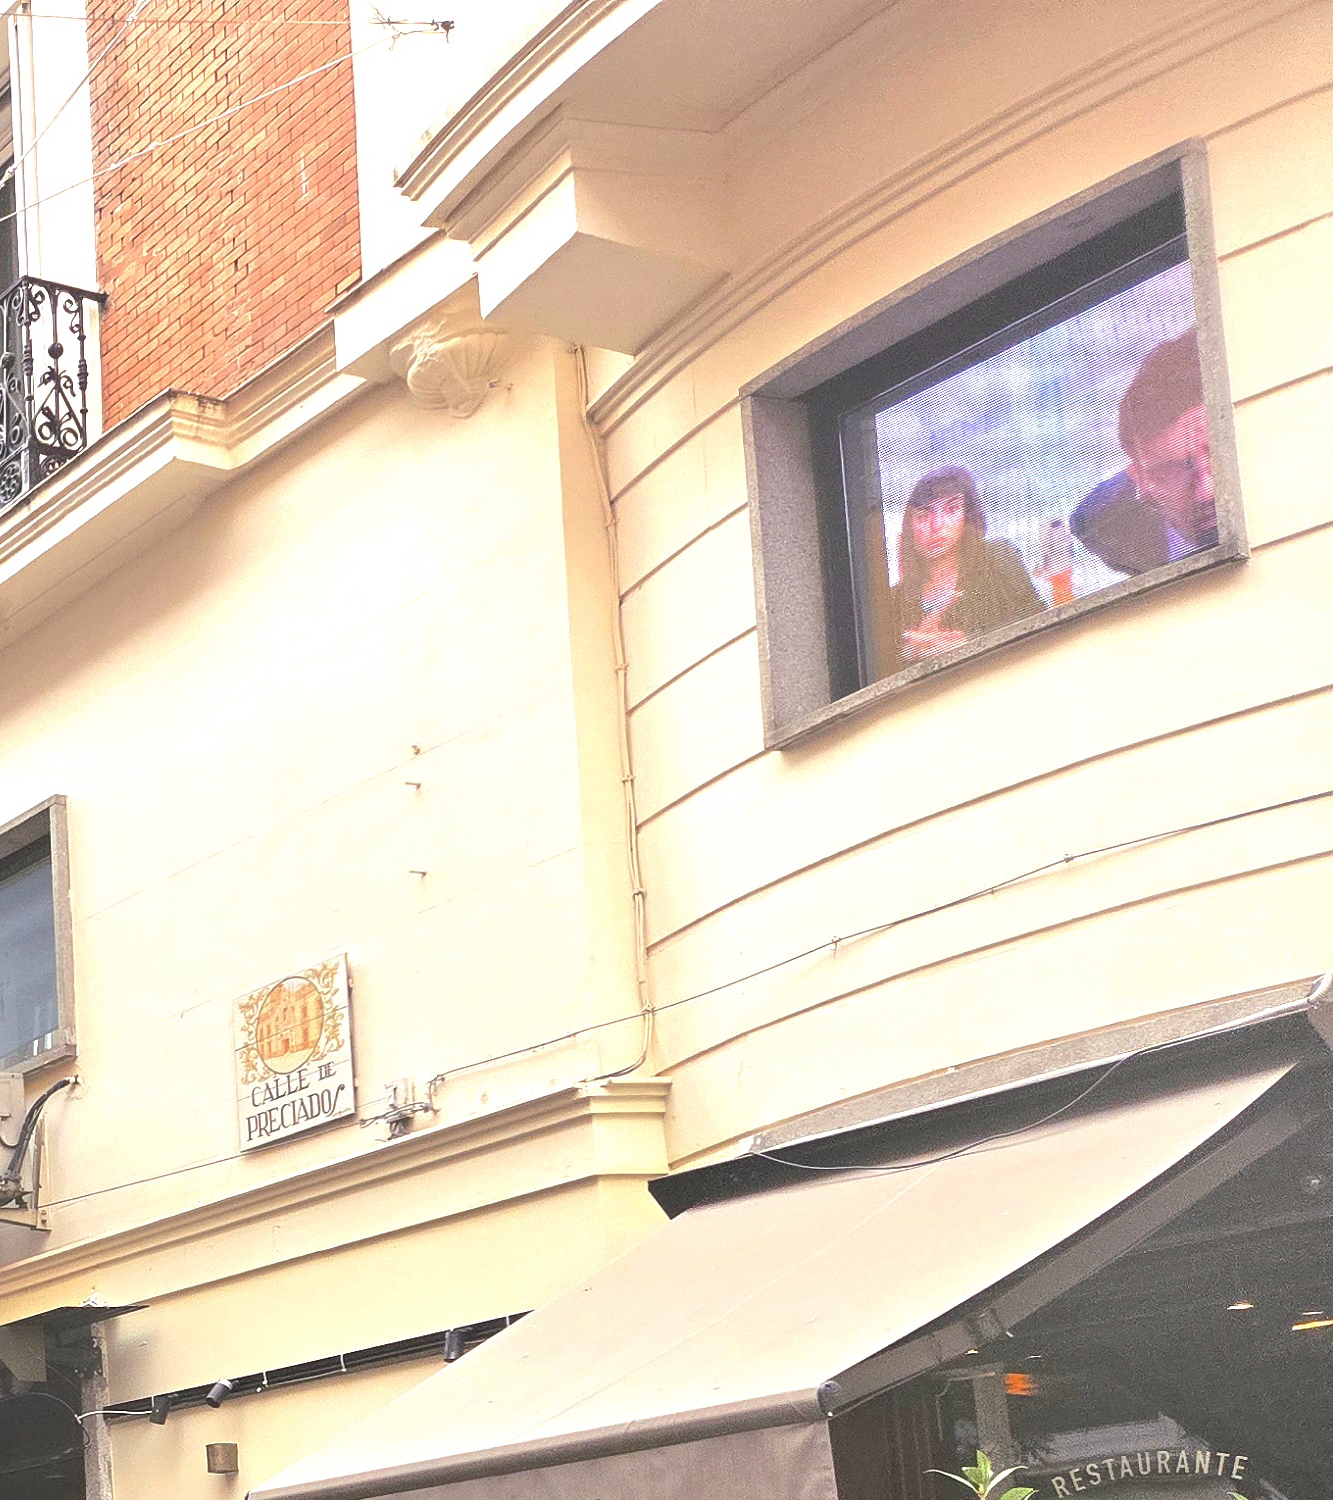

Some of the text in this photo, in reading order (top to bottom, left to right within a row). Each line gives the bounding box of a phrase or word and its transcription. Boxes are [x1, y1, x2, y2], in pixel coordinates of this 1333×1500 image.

[251, 1061, 337, 1107] CALLE DE
[1051, 1450, 1248, 1499] RESTAURANTE
